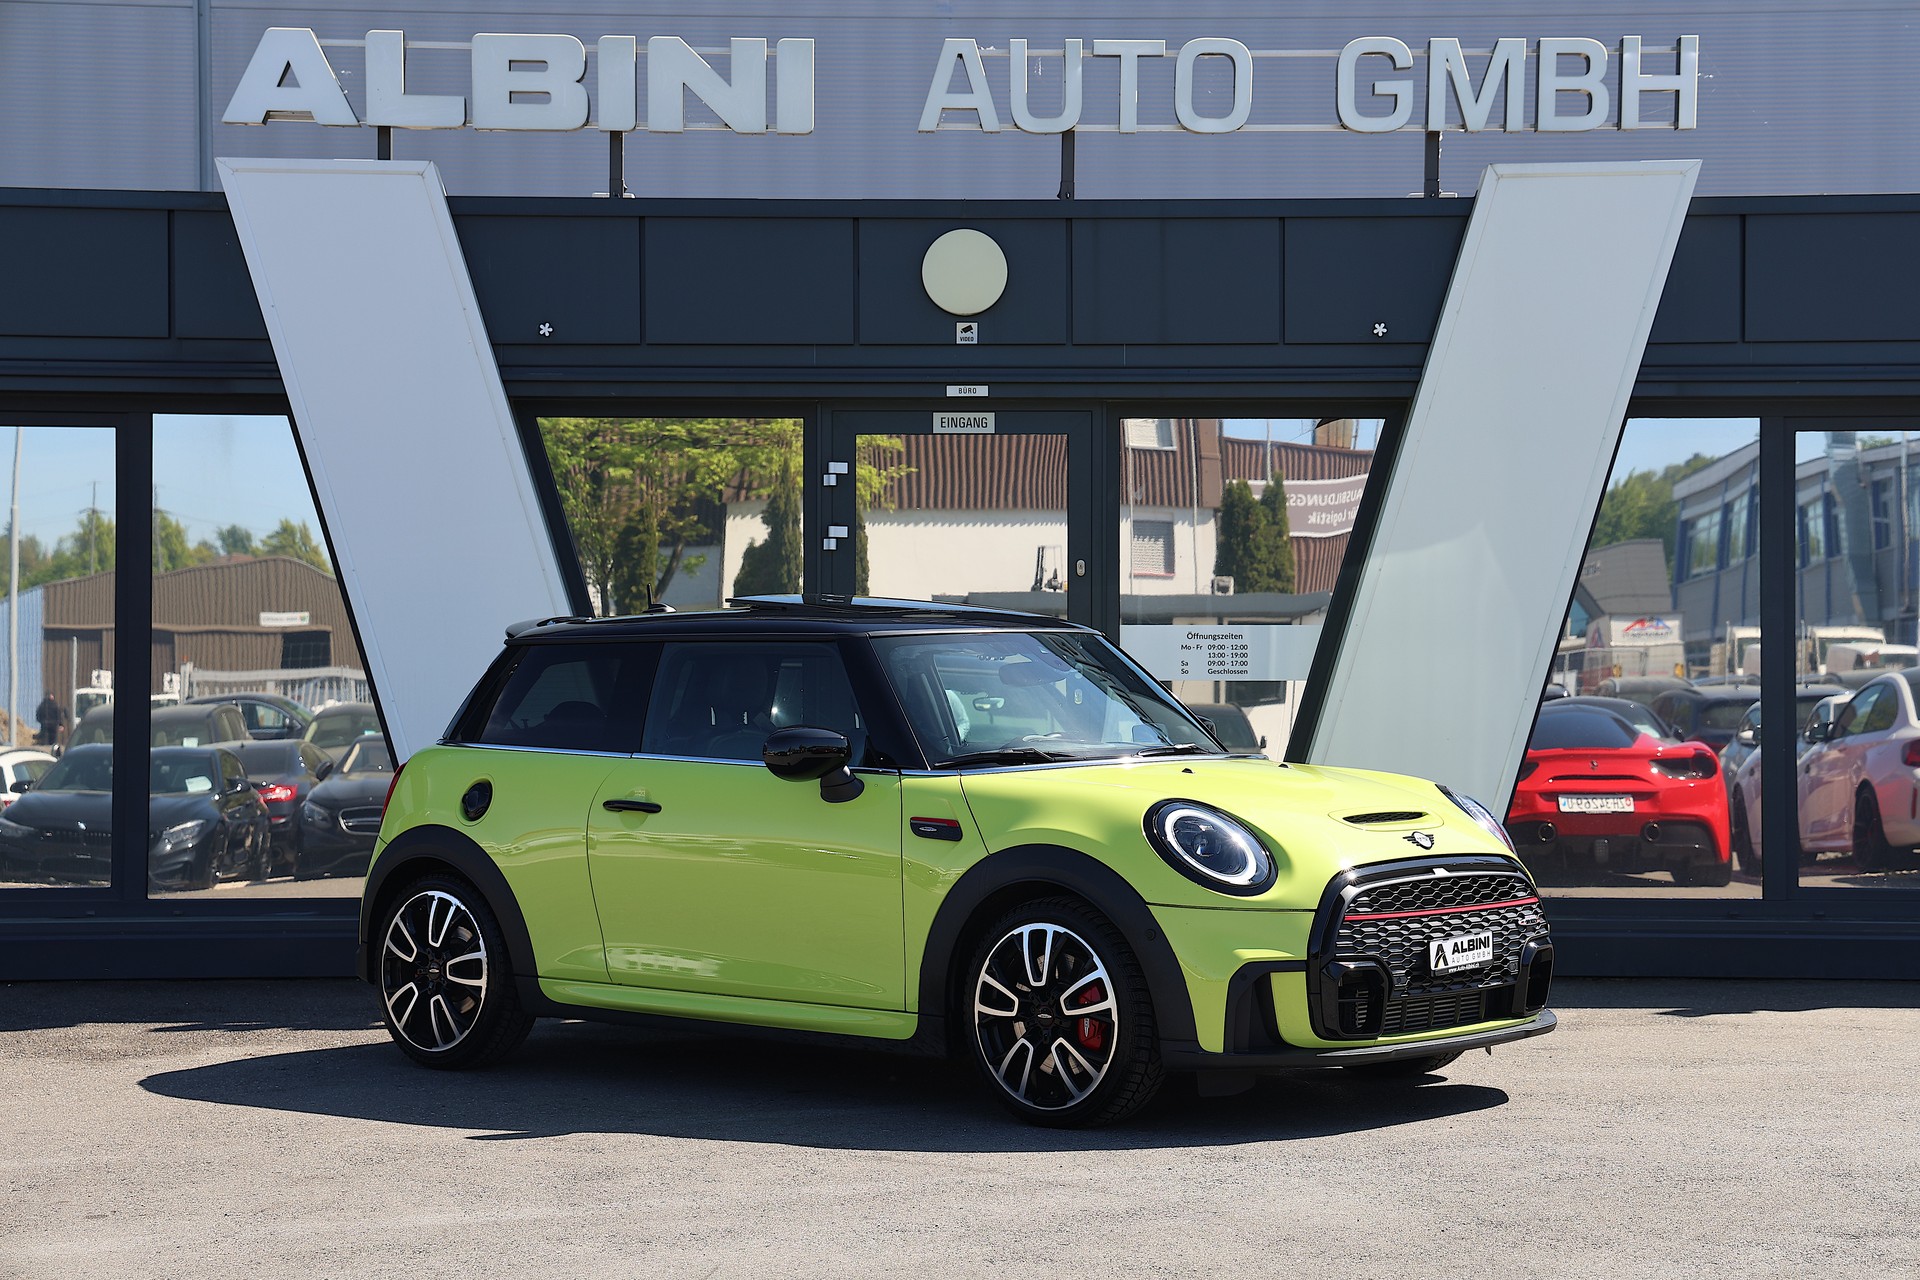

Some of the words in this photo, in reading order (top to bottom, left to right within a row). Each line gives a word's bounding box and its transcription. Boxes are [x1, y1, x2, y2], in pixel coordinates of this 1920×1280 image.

[222, 26, 816, 136] ALBINI
[918, 36, 1254, 135] AUTO
[1337, 34, 1700, 134] GMBH
[958, 386, 976, 394] BÜRO
[940, 416, 988, 428] EINGANG
[1186, 632, 1244, 641] Öffnungszeiten
[1452, 936, 1490, 955] ALBINI
